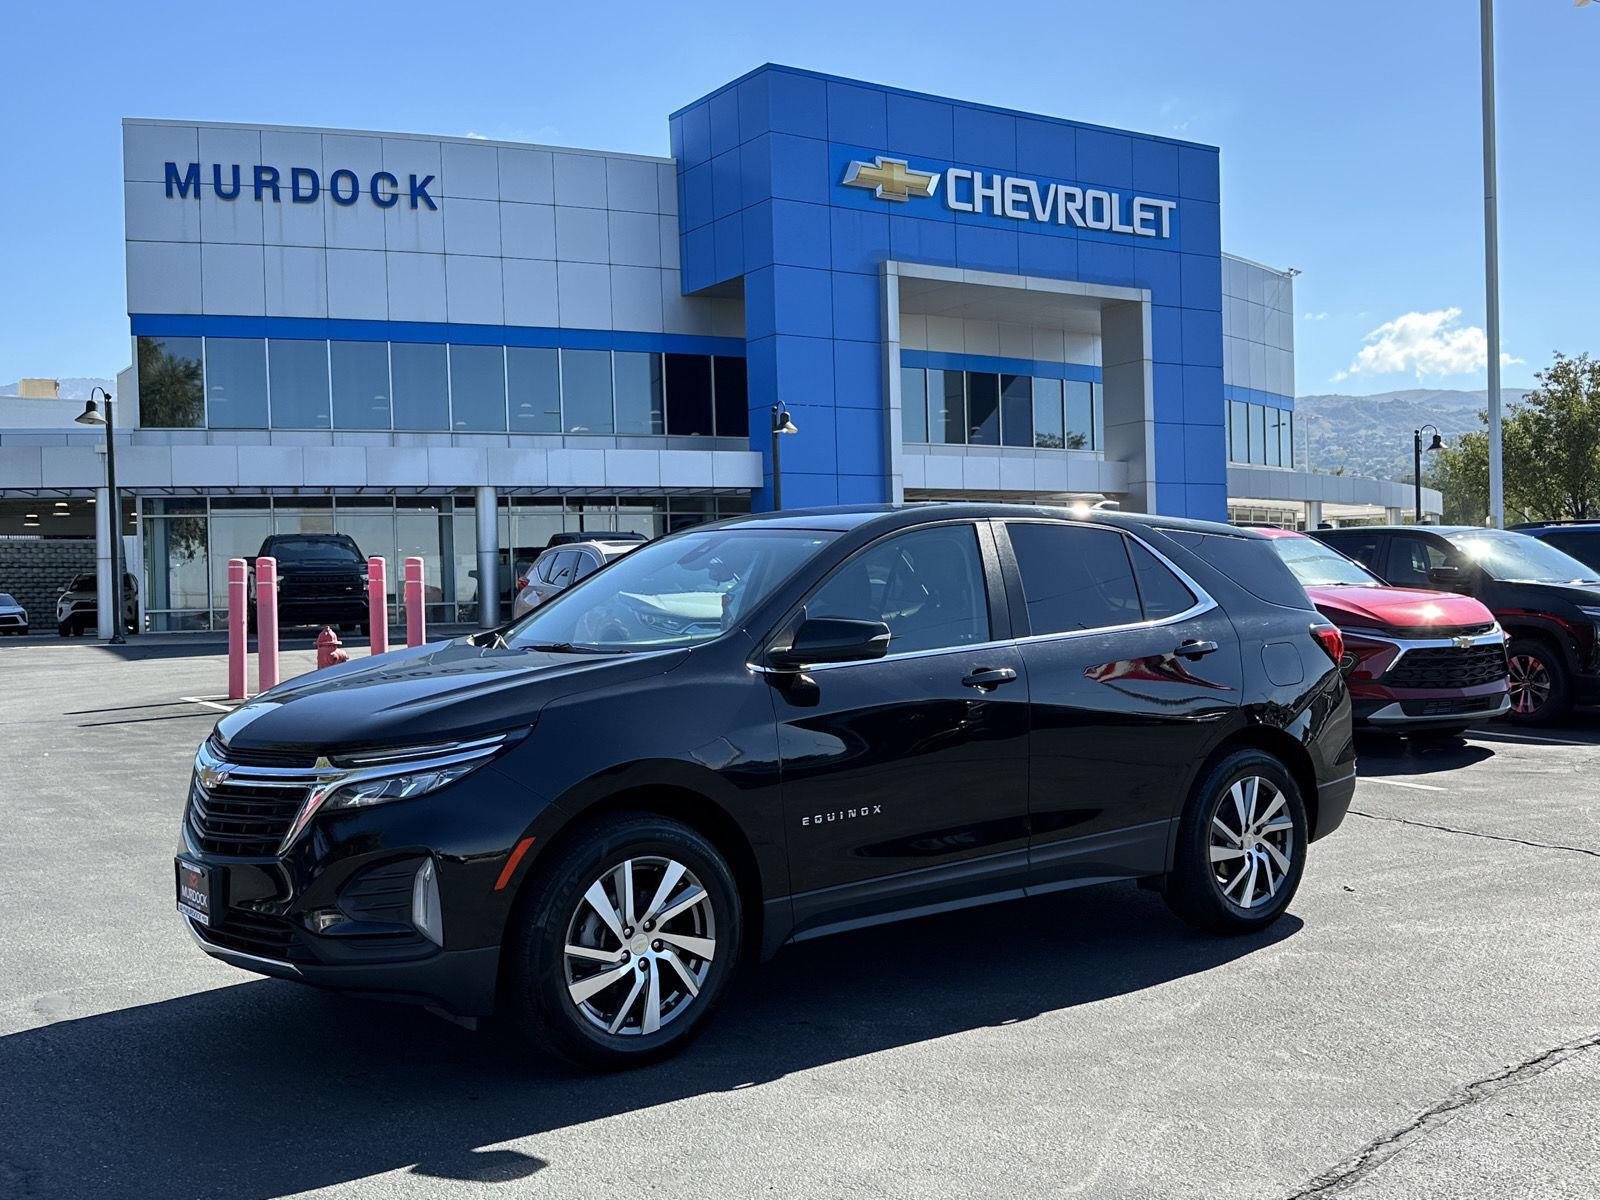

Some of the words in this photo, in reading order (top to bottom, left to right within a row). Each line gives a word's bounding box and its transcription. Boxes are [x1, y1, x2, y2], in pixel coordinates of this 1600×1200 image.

[164, 162, 438, 210] MURDOCK
[946, 167, 1177, 238] CHEVROLET
[802, 805, 881, 826] EQUINOX
[181, 885, 208, 908] MURDOCK
